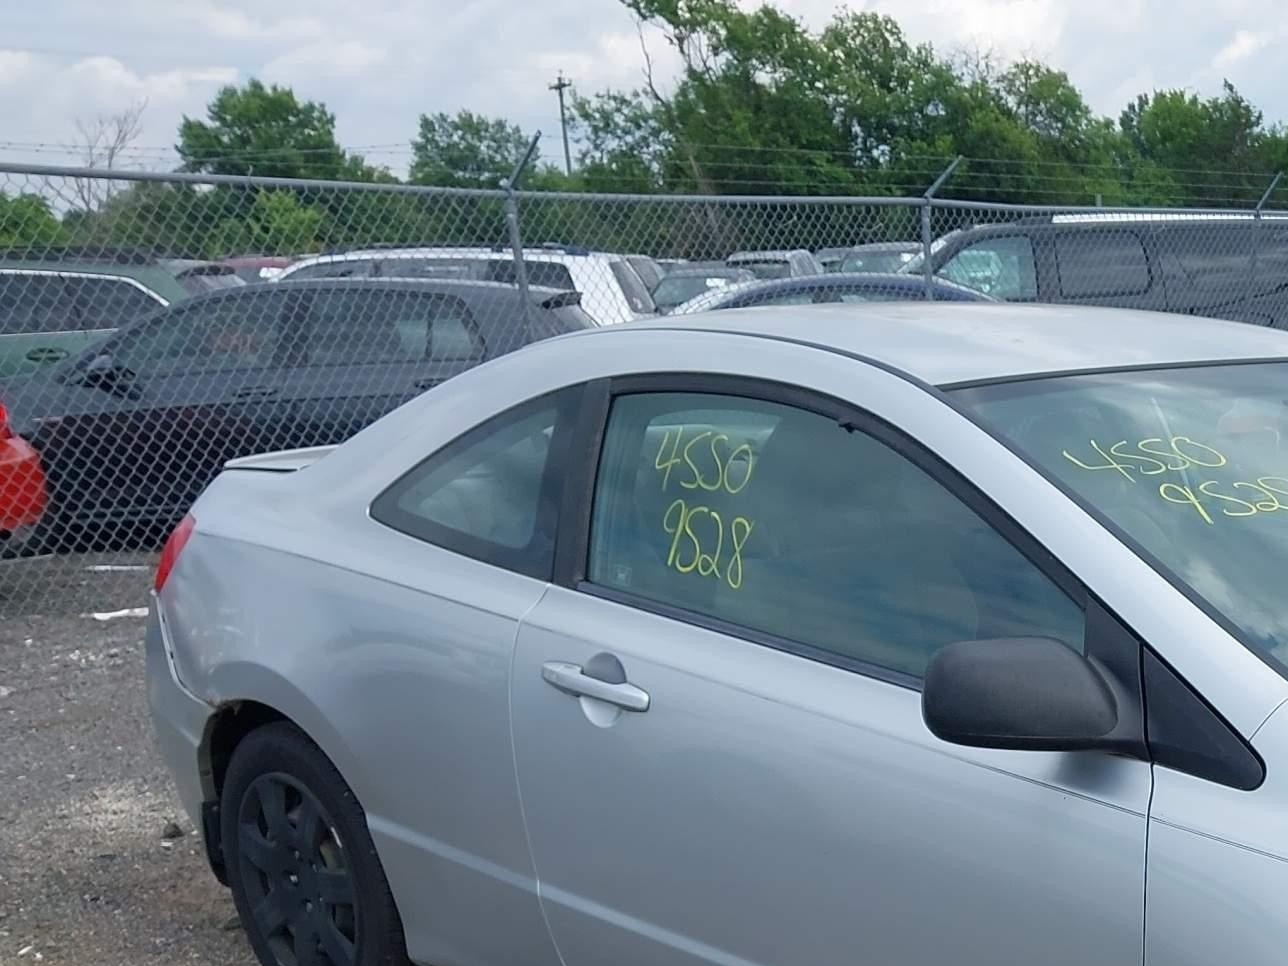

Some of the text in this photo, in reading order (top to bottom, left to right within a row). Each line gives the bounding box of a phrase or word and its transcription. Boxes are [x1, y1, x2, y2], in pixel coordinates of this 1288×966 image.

[655, 425, 754, 494] 4550
[1062, 436, 1227, 484] 4550
[663, 499, 755, 589] 9528
